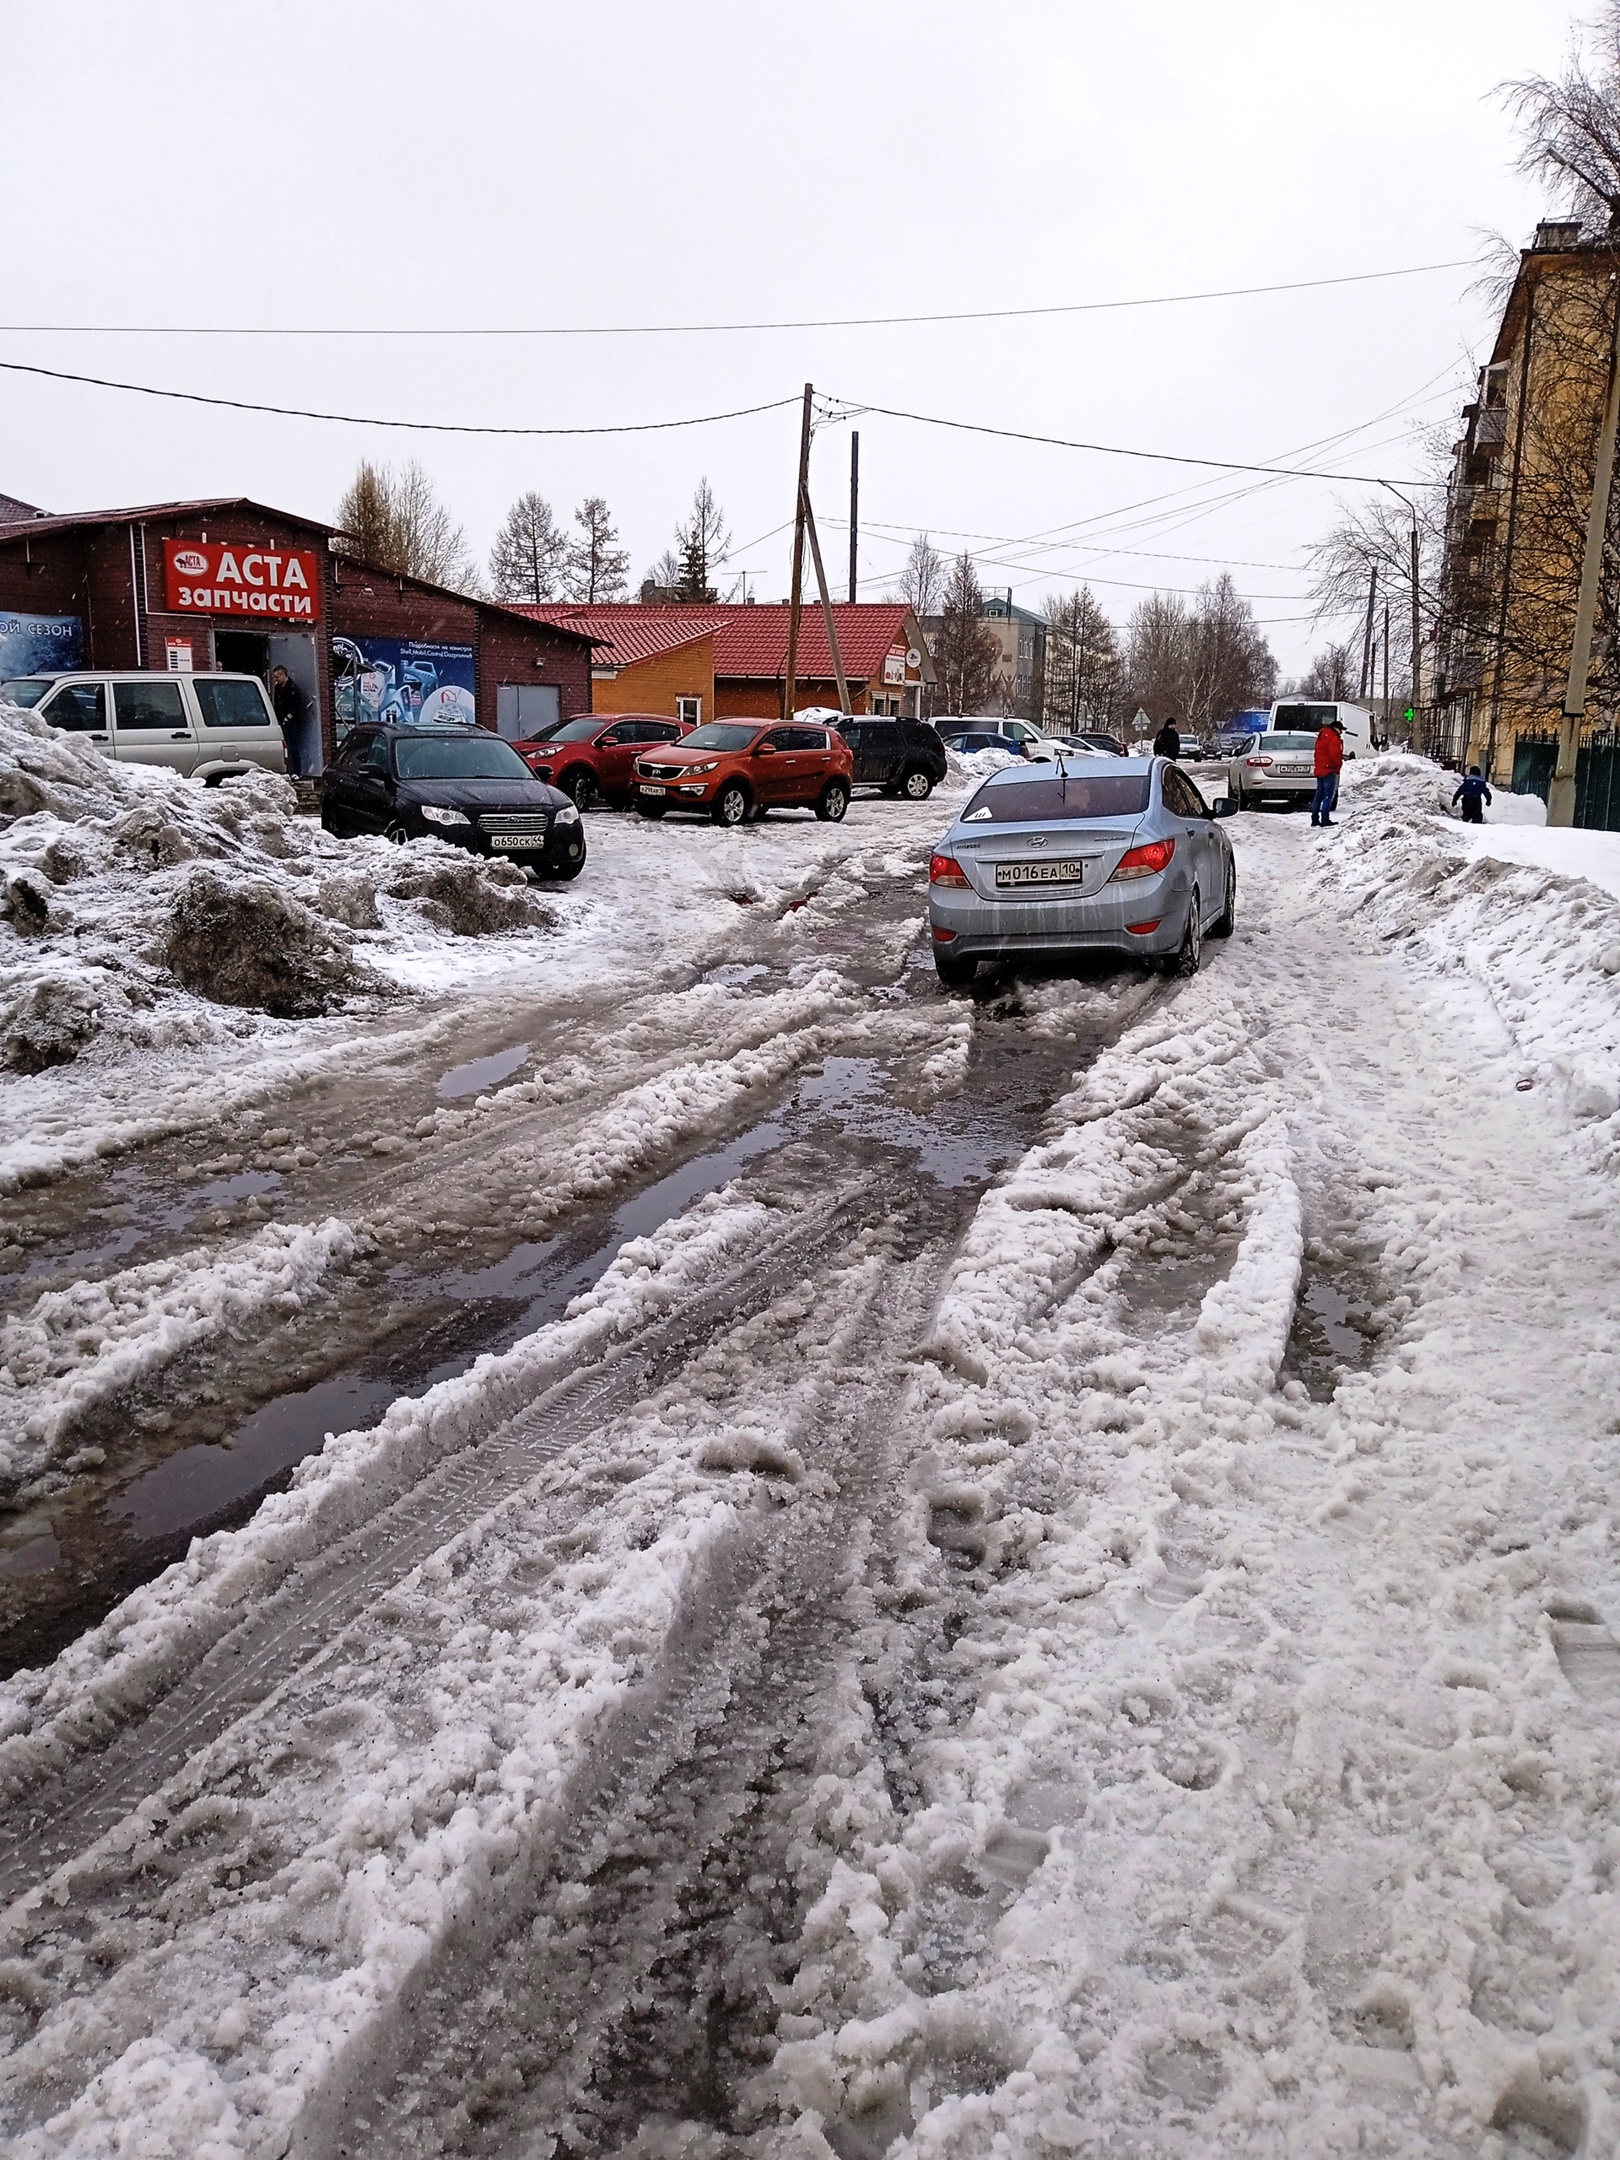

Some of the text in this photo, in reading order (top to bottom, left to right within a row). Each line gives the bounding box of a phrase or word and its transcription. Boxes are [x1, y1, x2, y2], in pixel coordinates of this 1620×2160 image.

[216, 552, 308, 589] АСТА
[178, 586, 312, 614] запчасти
[27, 623, 73, 637] СЕЗОН
[1002, 863, 1076, 881] М016ЕА 10
